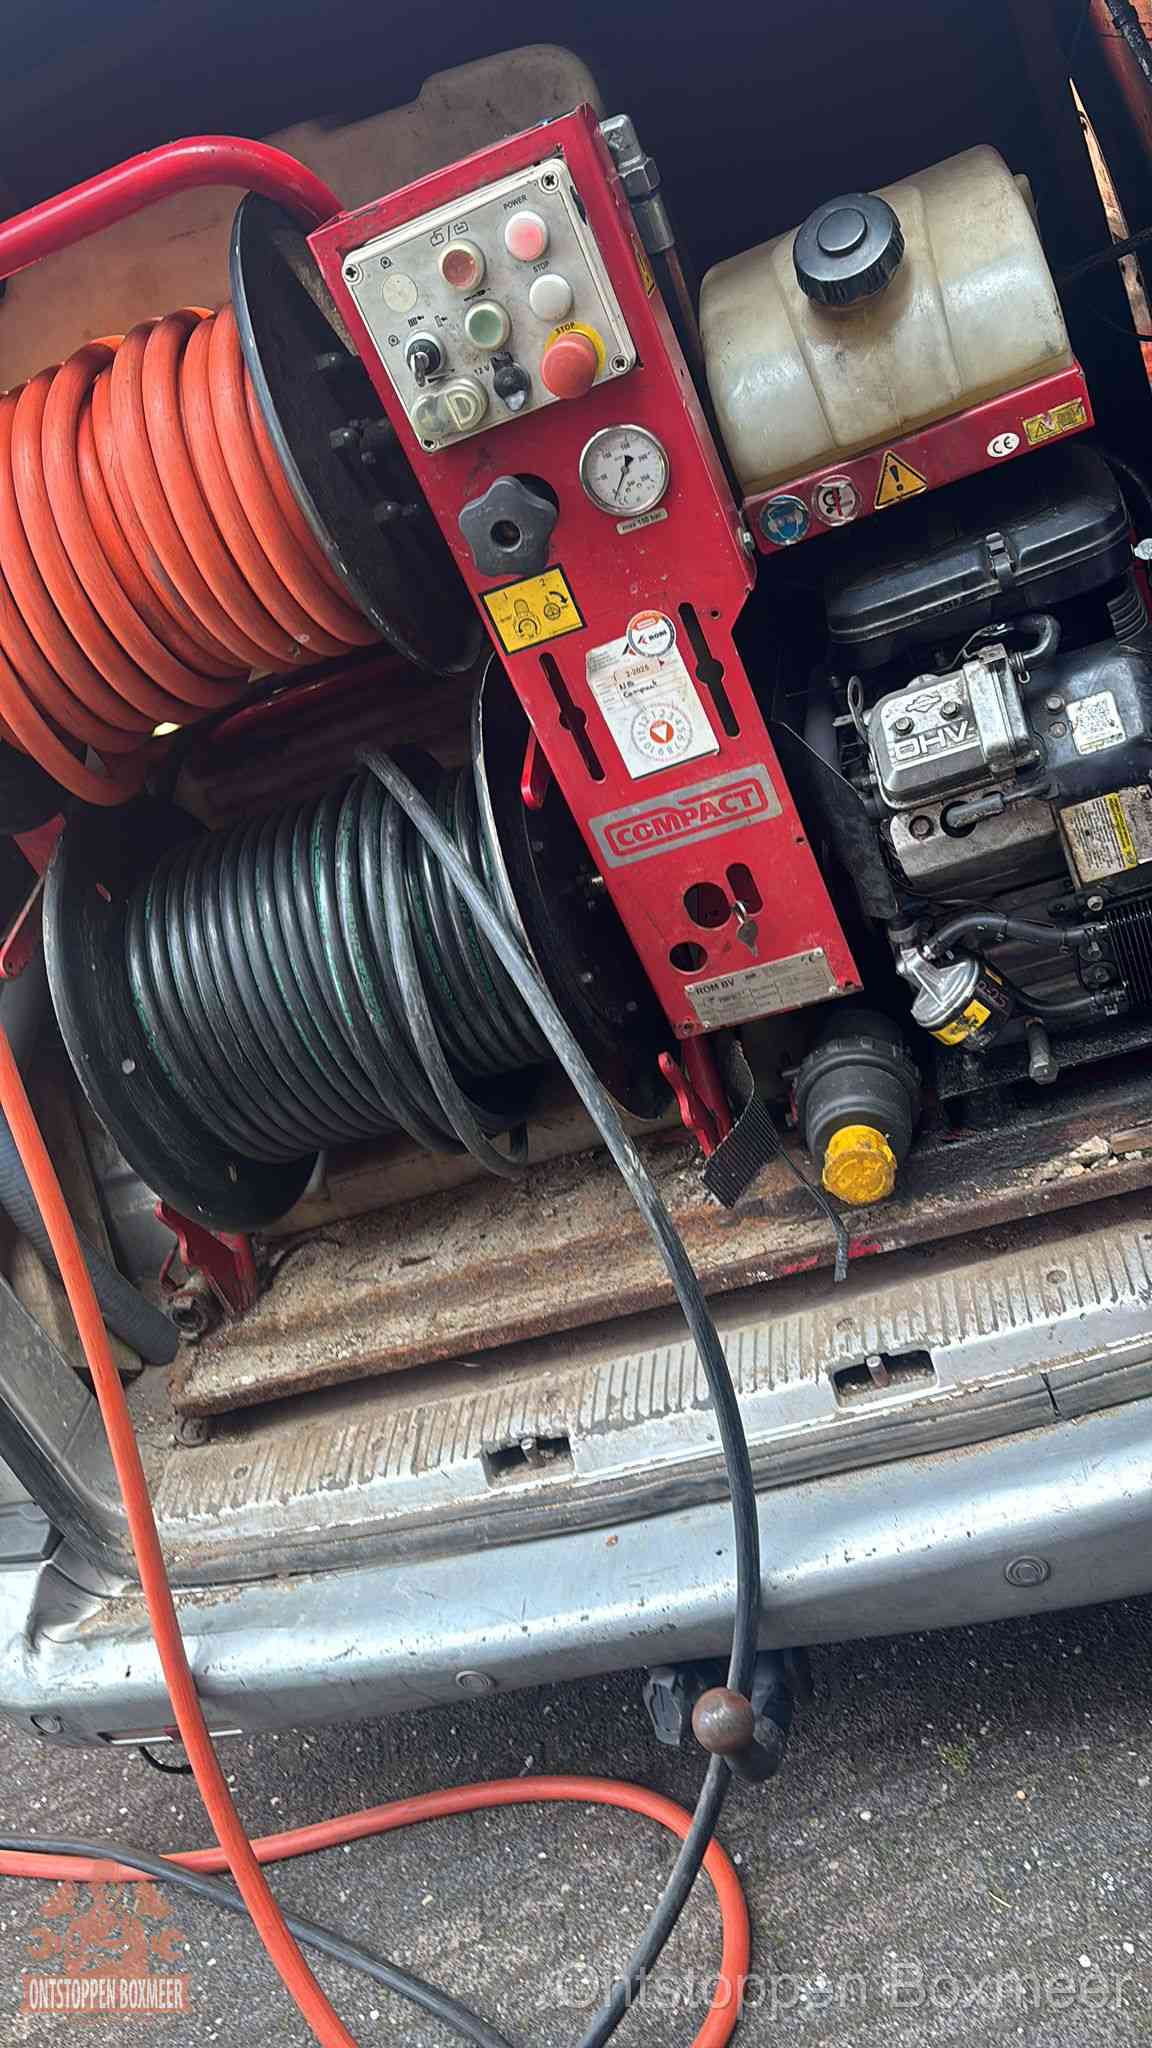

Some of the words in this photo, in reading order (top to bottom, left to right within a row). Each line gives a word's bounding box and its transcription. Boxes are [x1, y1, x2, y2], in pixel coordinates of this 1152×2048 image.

[503, 194, 528, 210] POWER
[532, 260, 550, 274] STOP
[555, 322, 576, 335] STOP
[992, 435, 1013, 454] CE
[615, 786, 755, 847] COMPACT
[695, 983, 720, 995] ROM
[721, 979, 735, 990] BV
